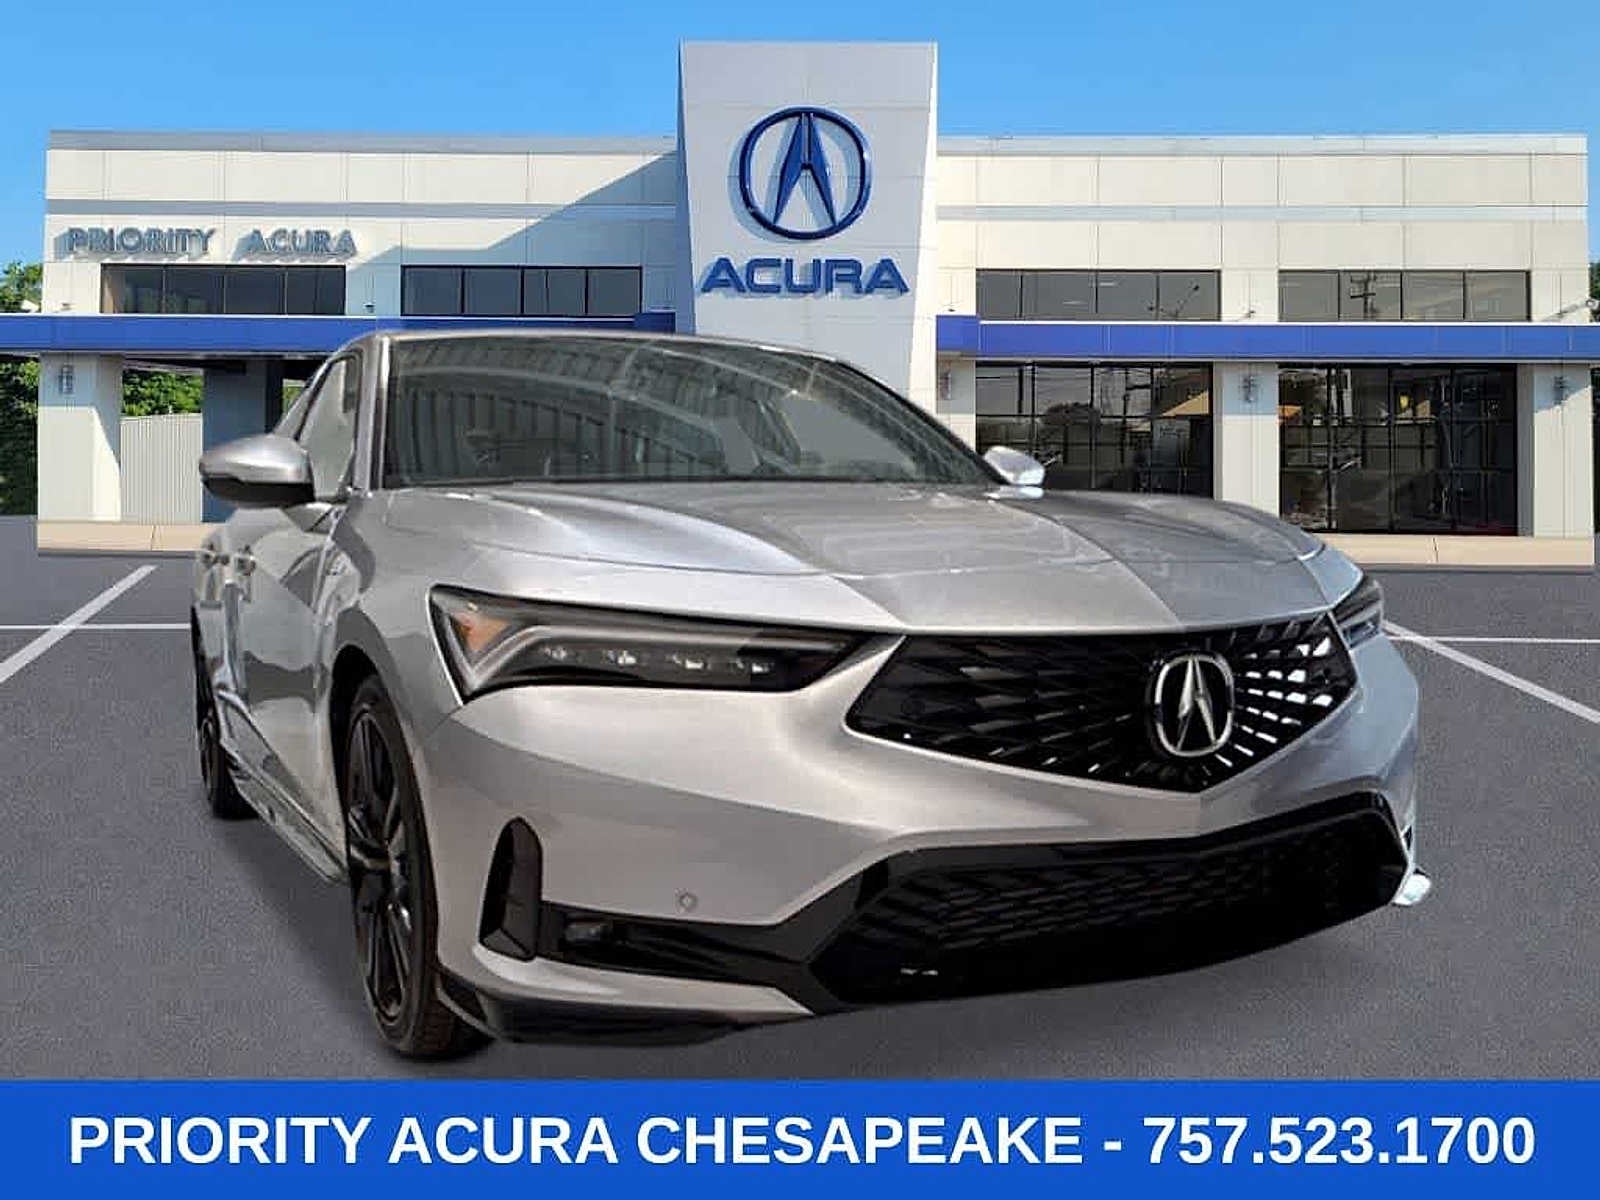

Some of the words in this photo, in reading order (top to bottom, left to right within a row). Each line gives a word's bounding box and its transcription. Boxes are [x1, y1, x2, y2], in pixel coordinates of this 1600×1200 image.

[67, 227, 216, 252] PRIORITY
[247, 228, 357, 256] ACURA
[701, 257, 909, 295] ACURA
